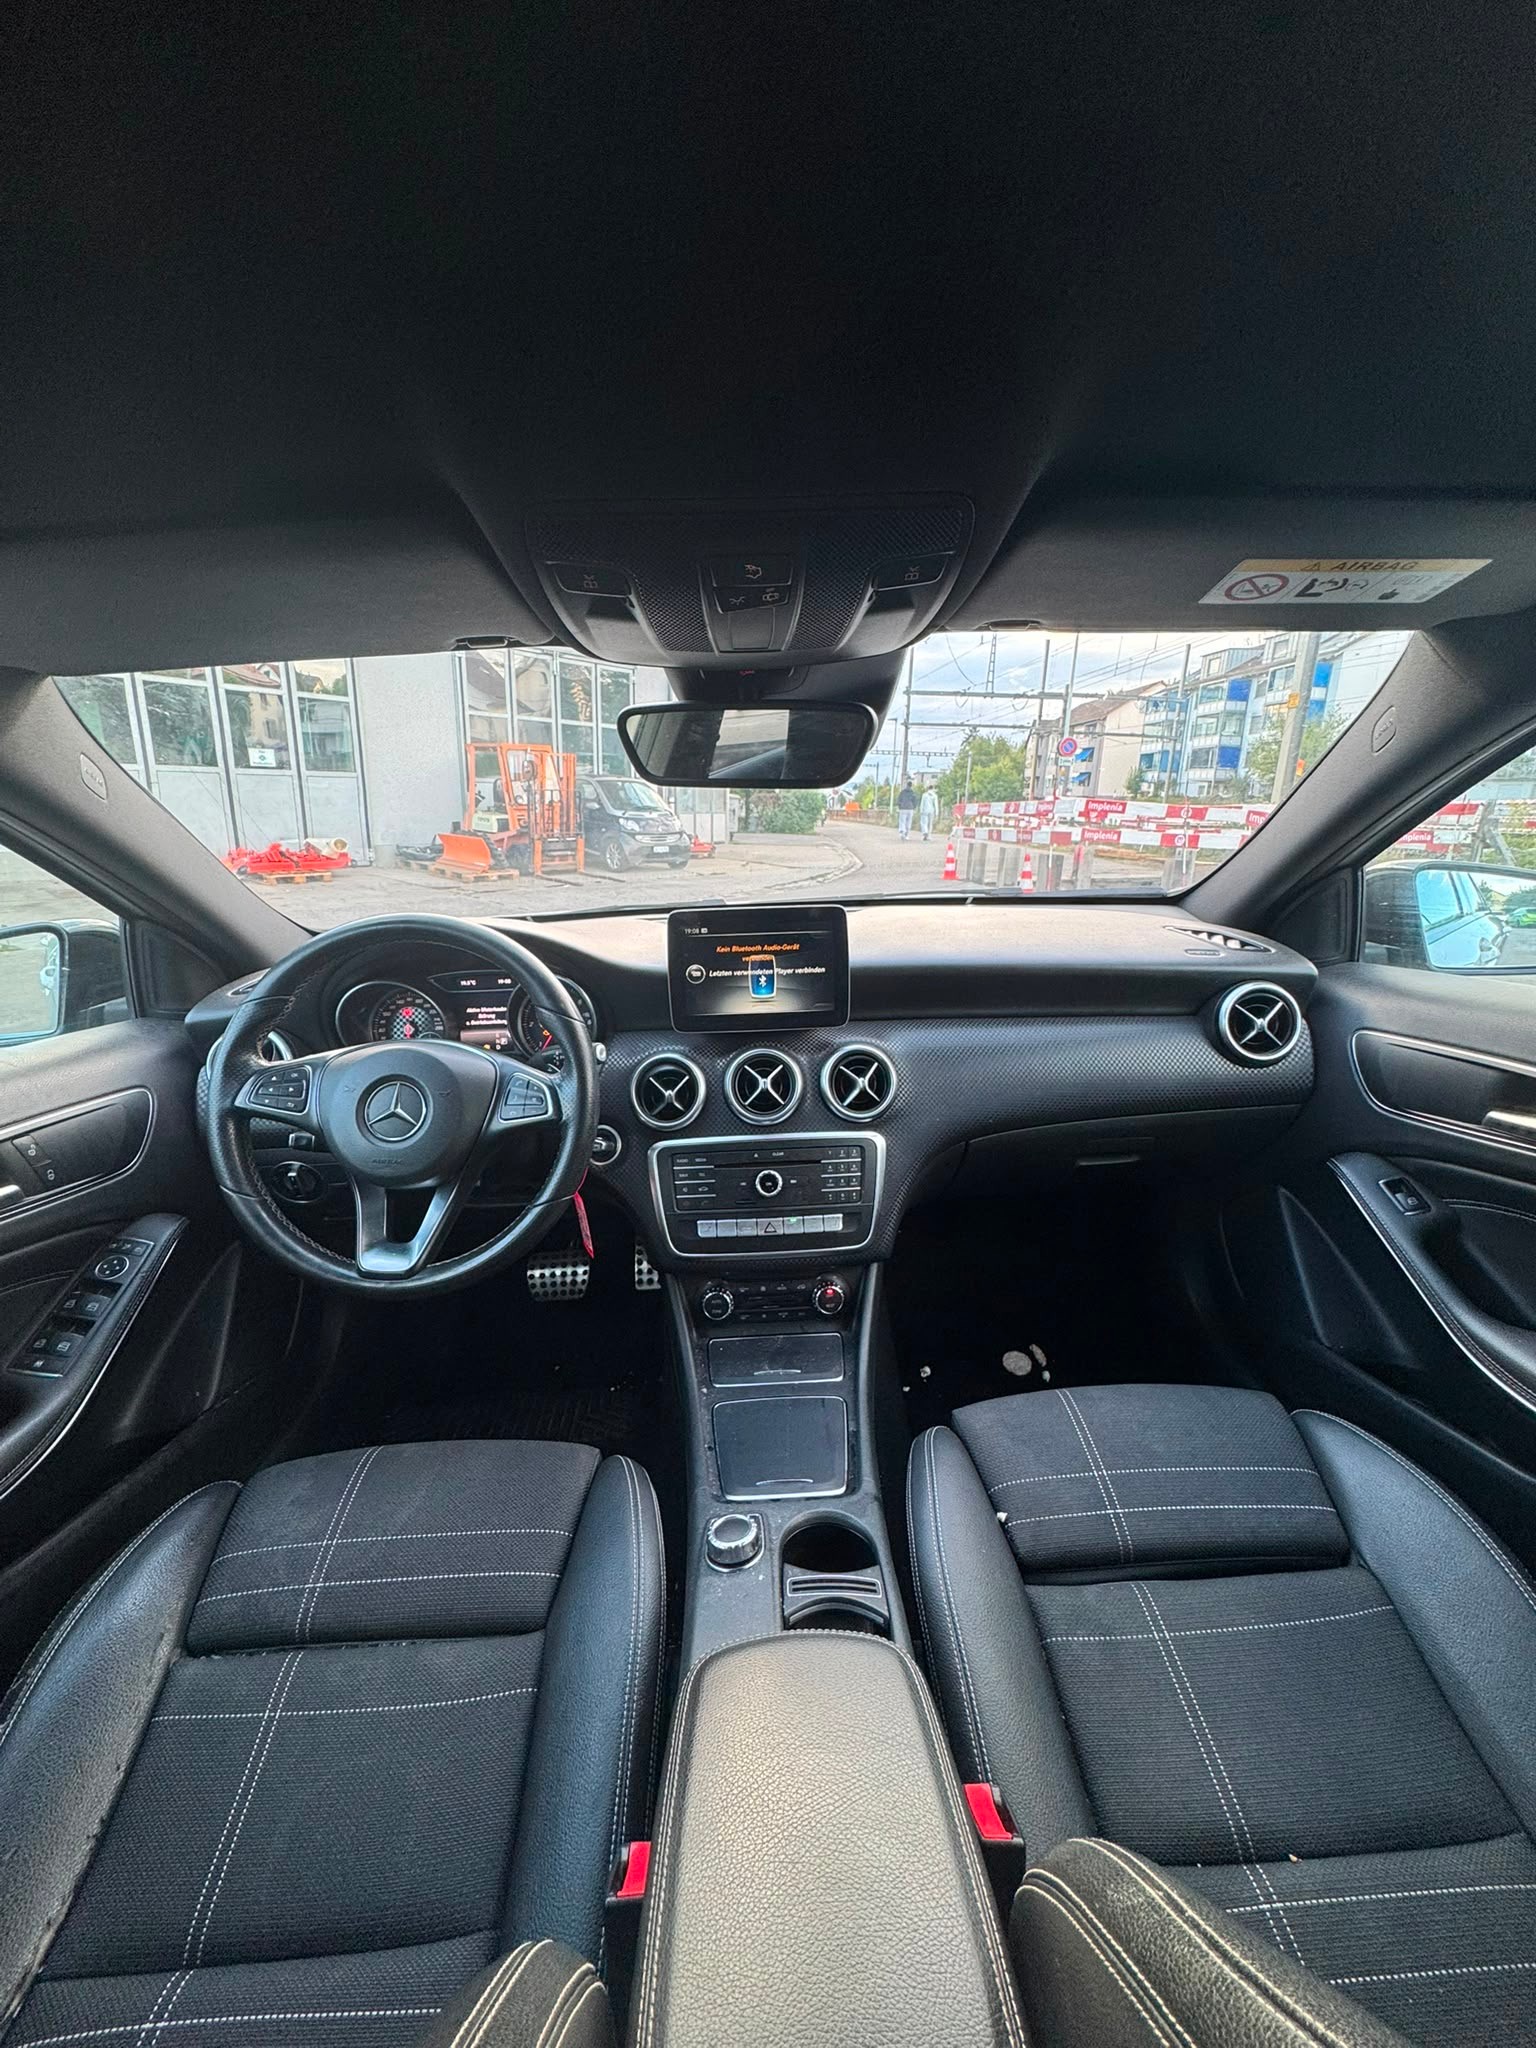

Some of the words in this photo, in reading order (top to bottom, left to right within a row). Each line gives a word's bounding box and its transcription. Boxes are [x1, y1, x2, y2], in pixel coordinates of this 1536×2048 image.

[1333, 561, 1418, 571] AIRBAG
[1087, 801, 1123, 812] Implenia
[1084, 831, 1118, 841] Implenia
[716, 945, 730, 953] Kein
[731, 944, 762, 952] Bluetooth
[763, 943, 800, 951] Audio-Gerät
[774, 967, 794, 976] Player
[795, 966, 825, 974] verbinden
